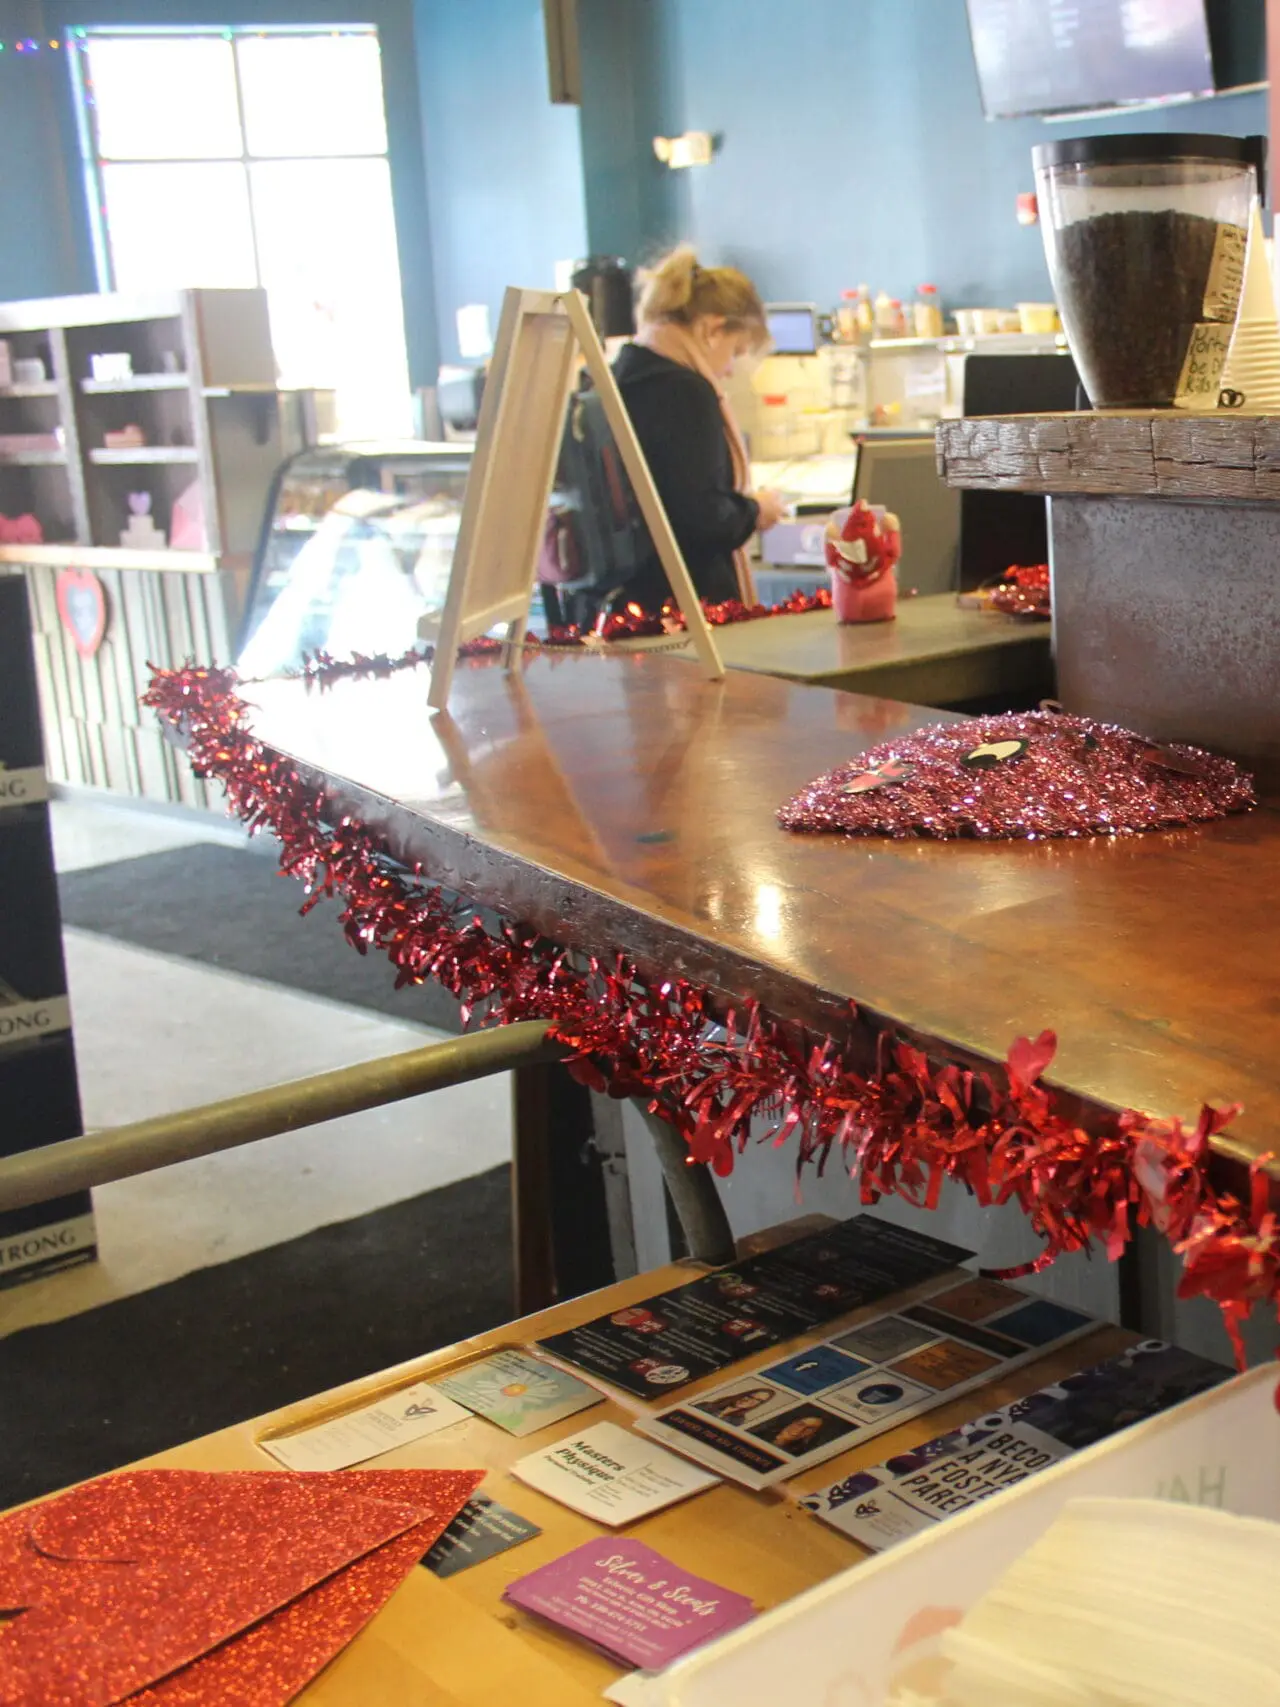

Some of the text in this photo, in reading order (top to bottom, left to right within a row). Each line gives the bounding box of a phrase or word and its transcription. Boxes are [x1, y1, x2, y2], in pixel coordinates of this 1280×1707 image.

[555, 1447, 616, 1482] Physique
[572, 1440, 627, 1472] Masters
[958, 1449, 987, 1465] A
[987, 1433, 1058, 1472] BECO
[901, 1474, 975, 1514] PARE
